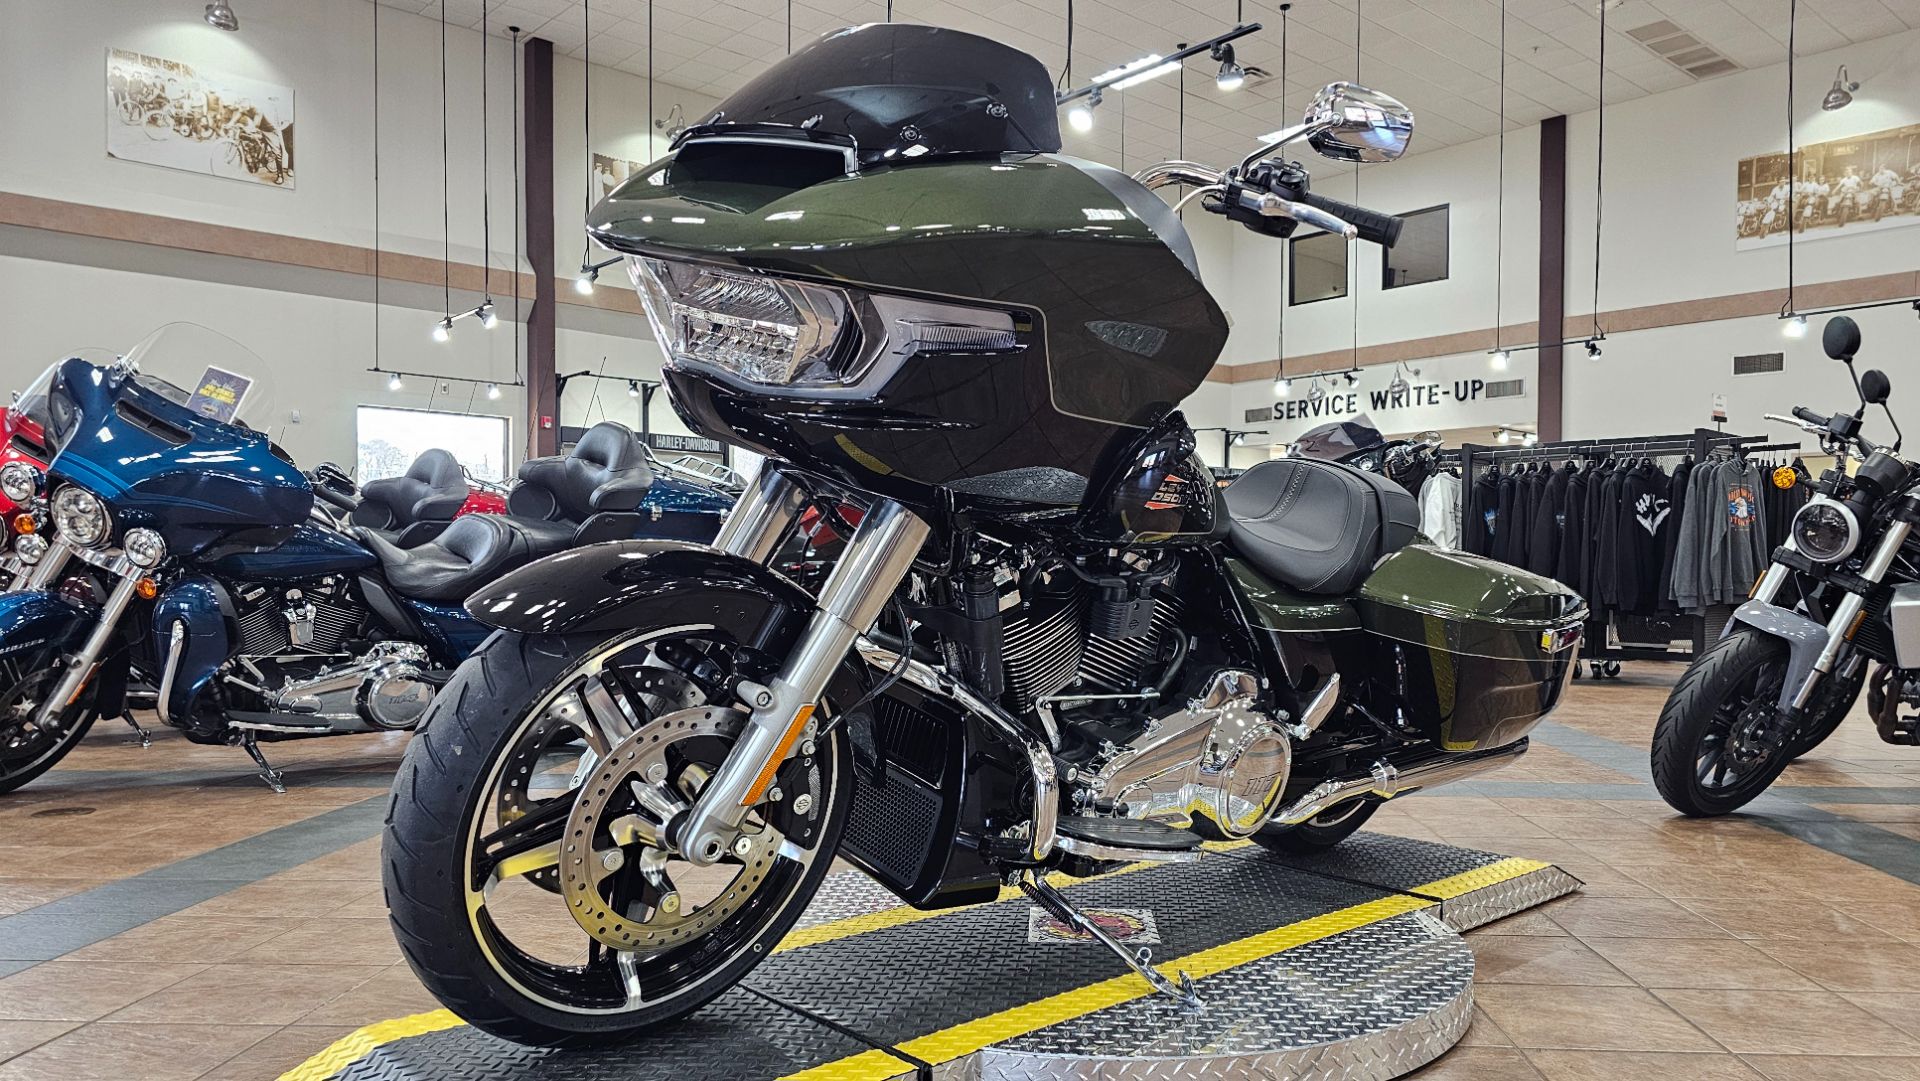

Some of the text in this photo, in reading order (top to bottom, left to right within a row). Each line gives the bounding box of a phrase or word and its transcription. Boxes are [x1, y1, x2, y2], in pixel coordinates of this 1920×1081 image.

[1273, 379, 1484, 420] SERVICE WRITE-UP
[655, 434, 721, 452] HARLEY-DAVIDSON
